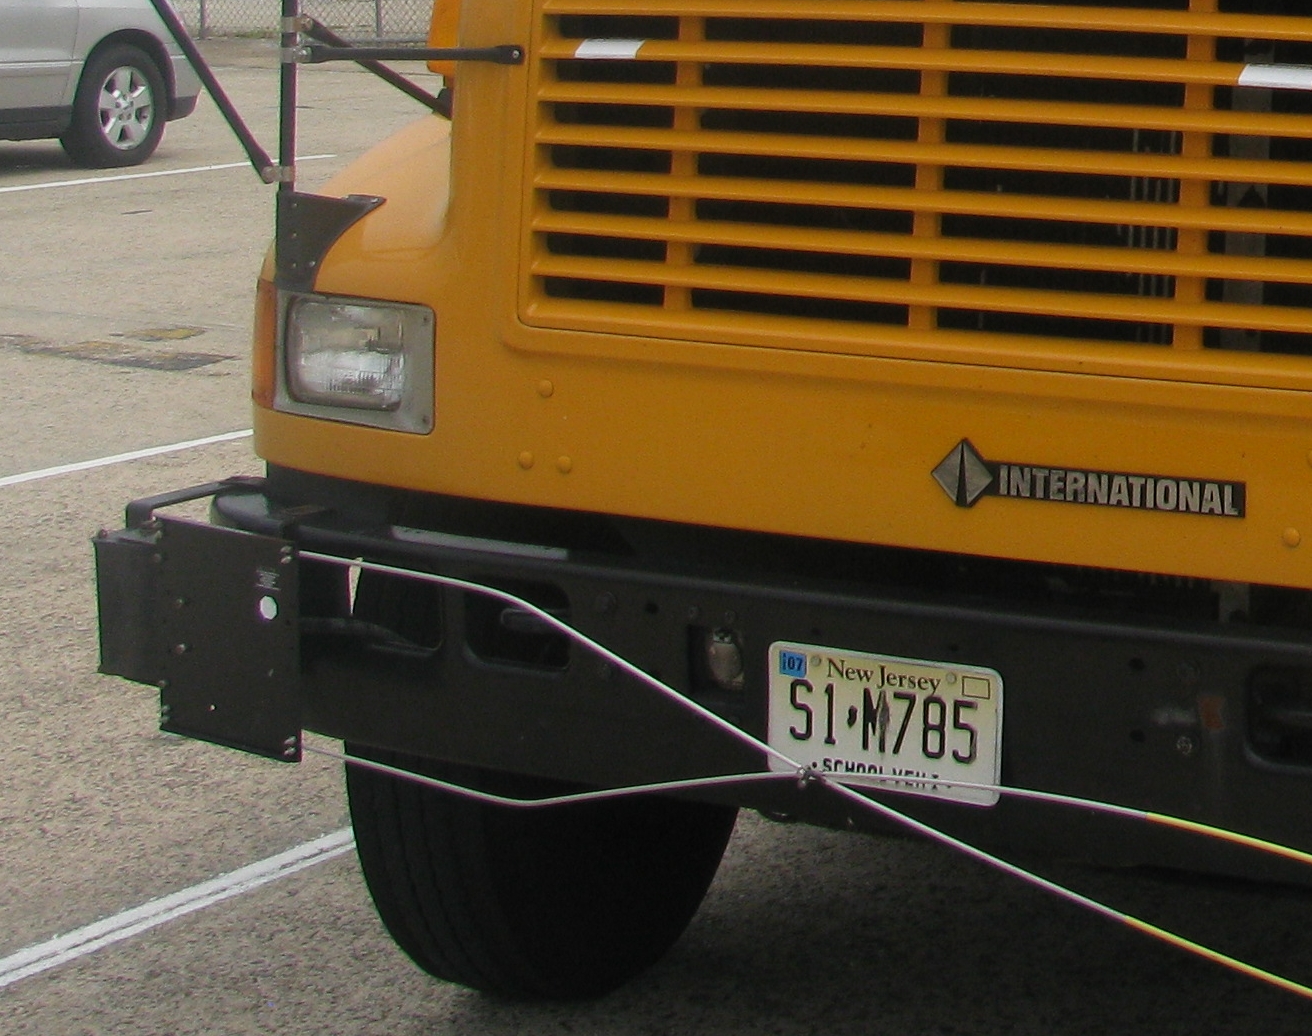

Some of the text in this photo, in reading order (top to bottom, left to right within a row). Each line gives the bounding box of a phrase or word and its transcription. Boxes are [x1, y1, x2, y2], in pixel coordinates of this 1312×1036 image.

[1000, 464, 1239, 516] INTERNATIONAL
[787, 656, 803, 672] 07
[827, 657, 942, 695] New Jersey
